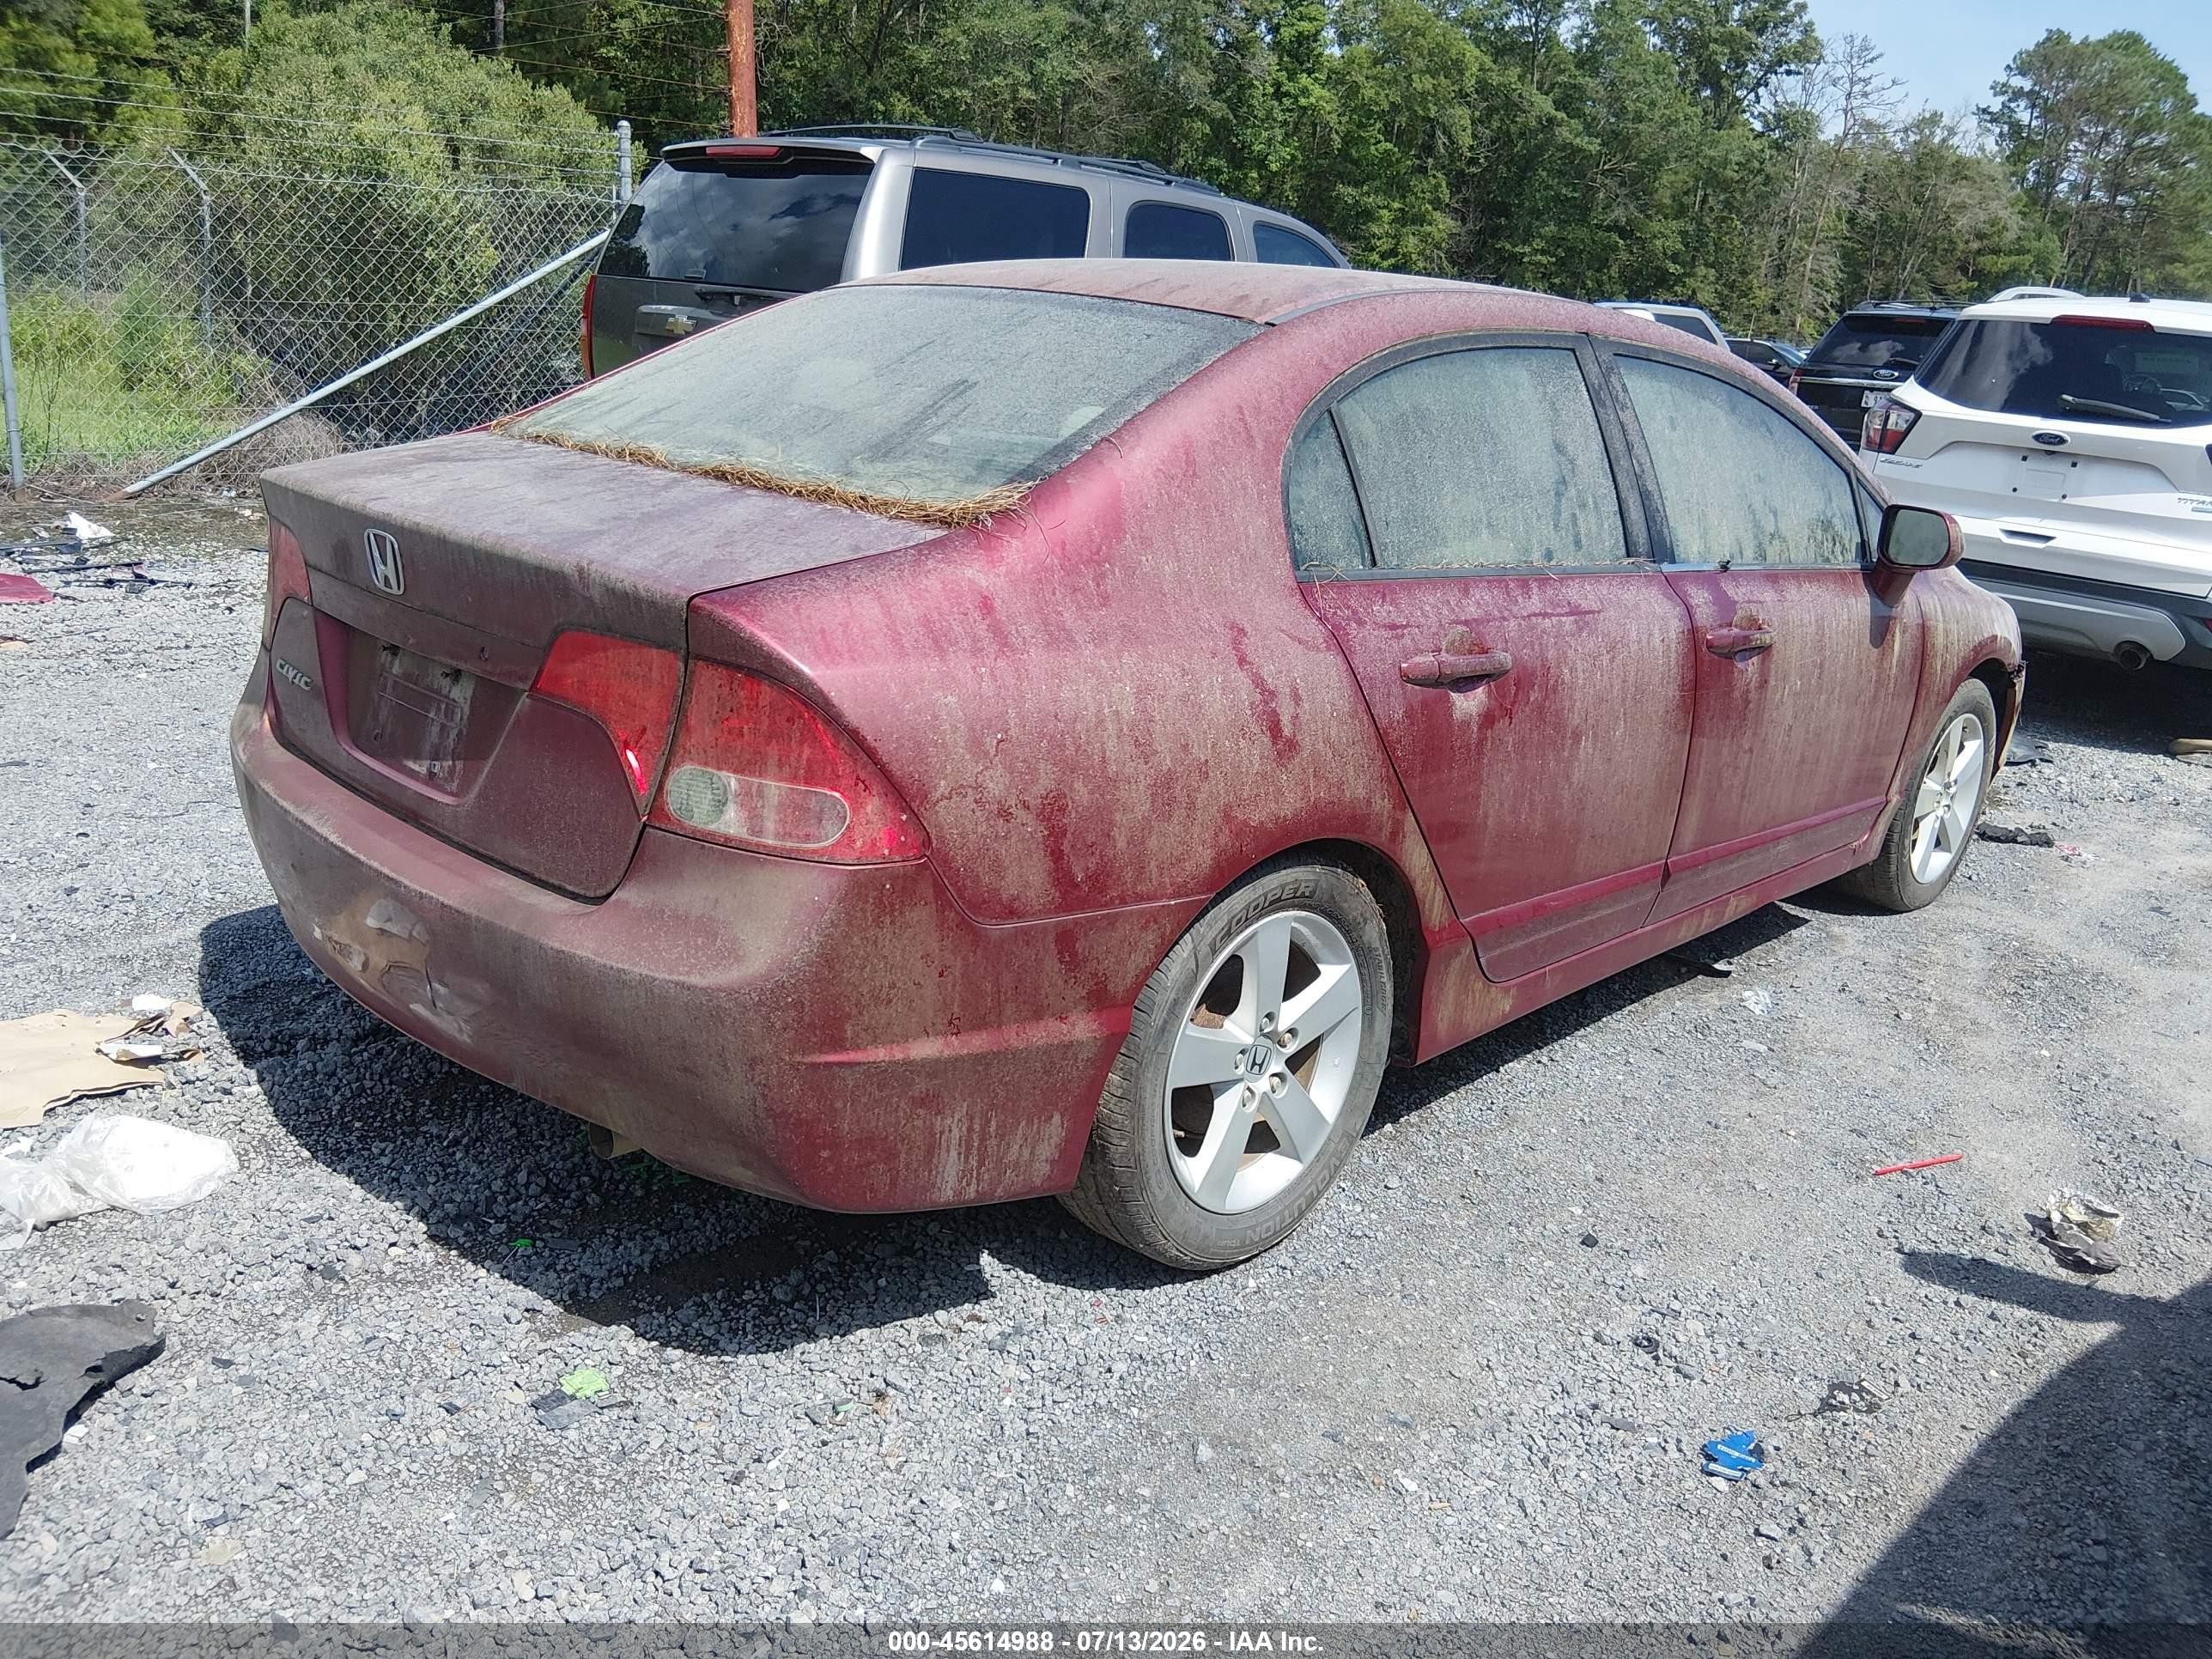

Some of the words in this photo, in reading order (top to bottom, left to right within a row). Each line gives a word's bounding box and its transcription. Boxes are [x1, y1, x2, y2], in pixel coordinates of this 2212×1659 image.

[276, 658, 313, 691] CIVIC
[1214, 880, 1315, 951] COOPER
[1246, 1134, 1354, 1244] EVOLUTION
